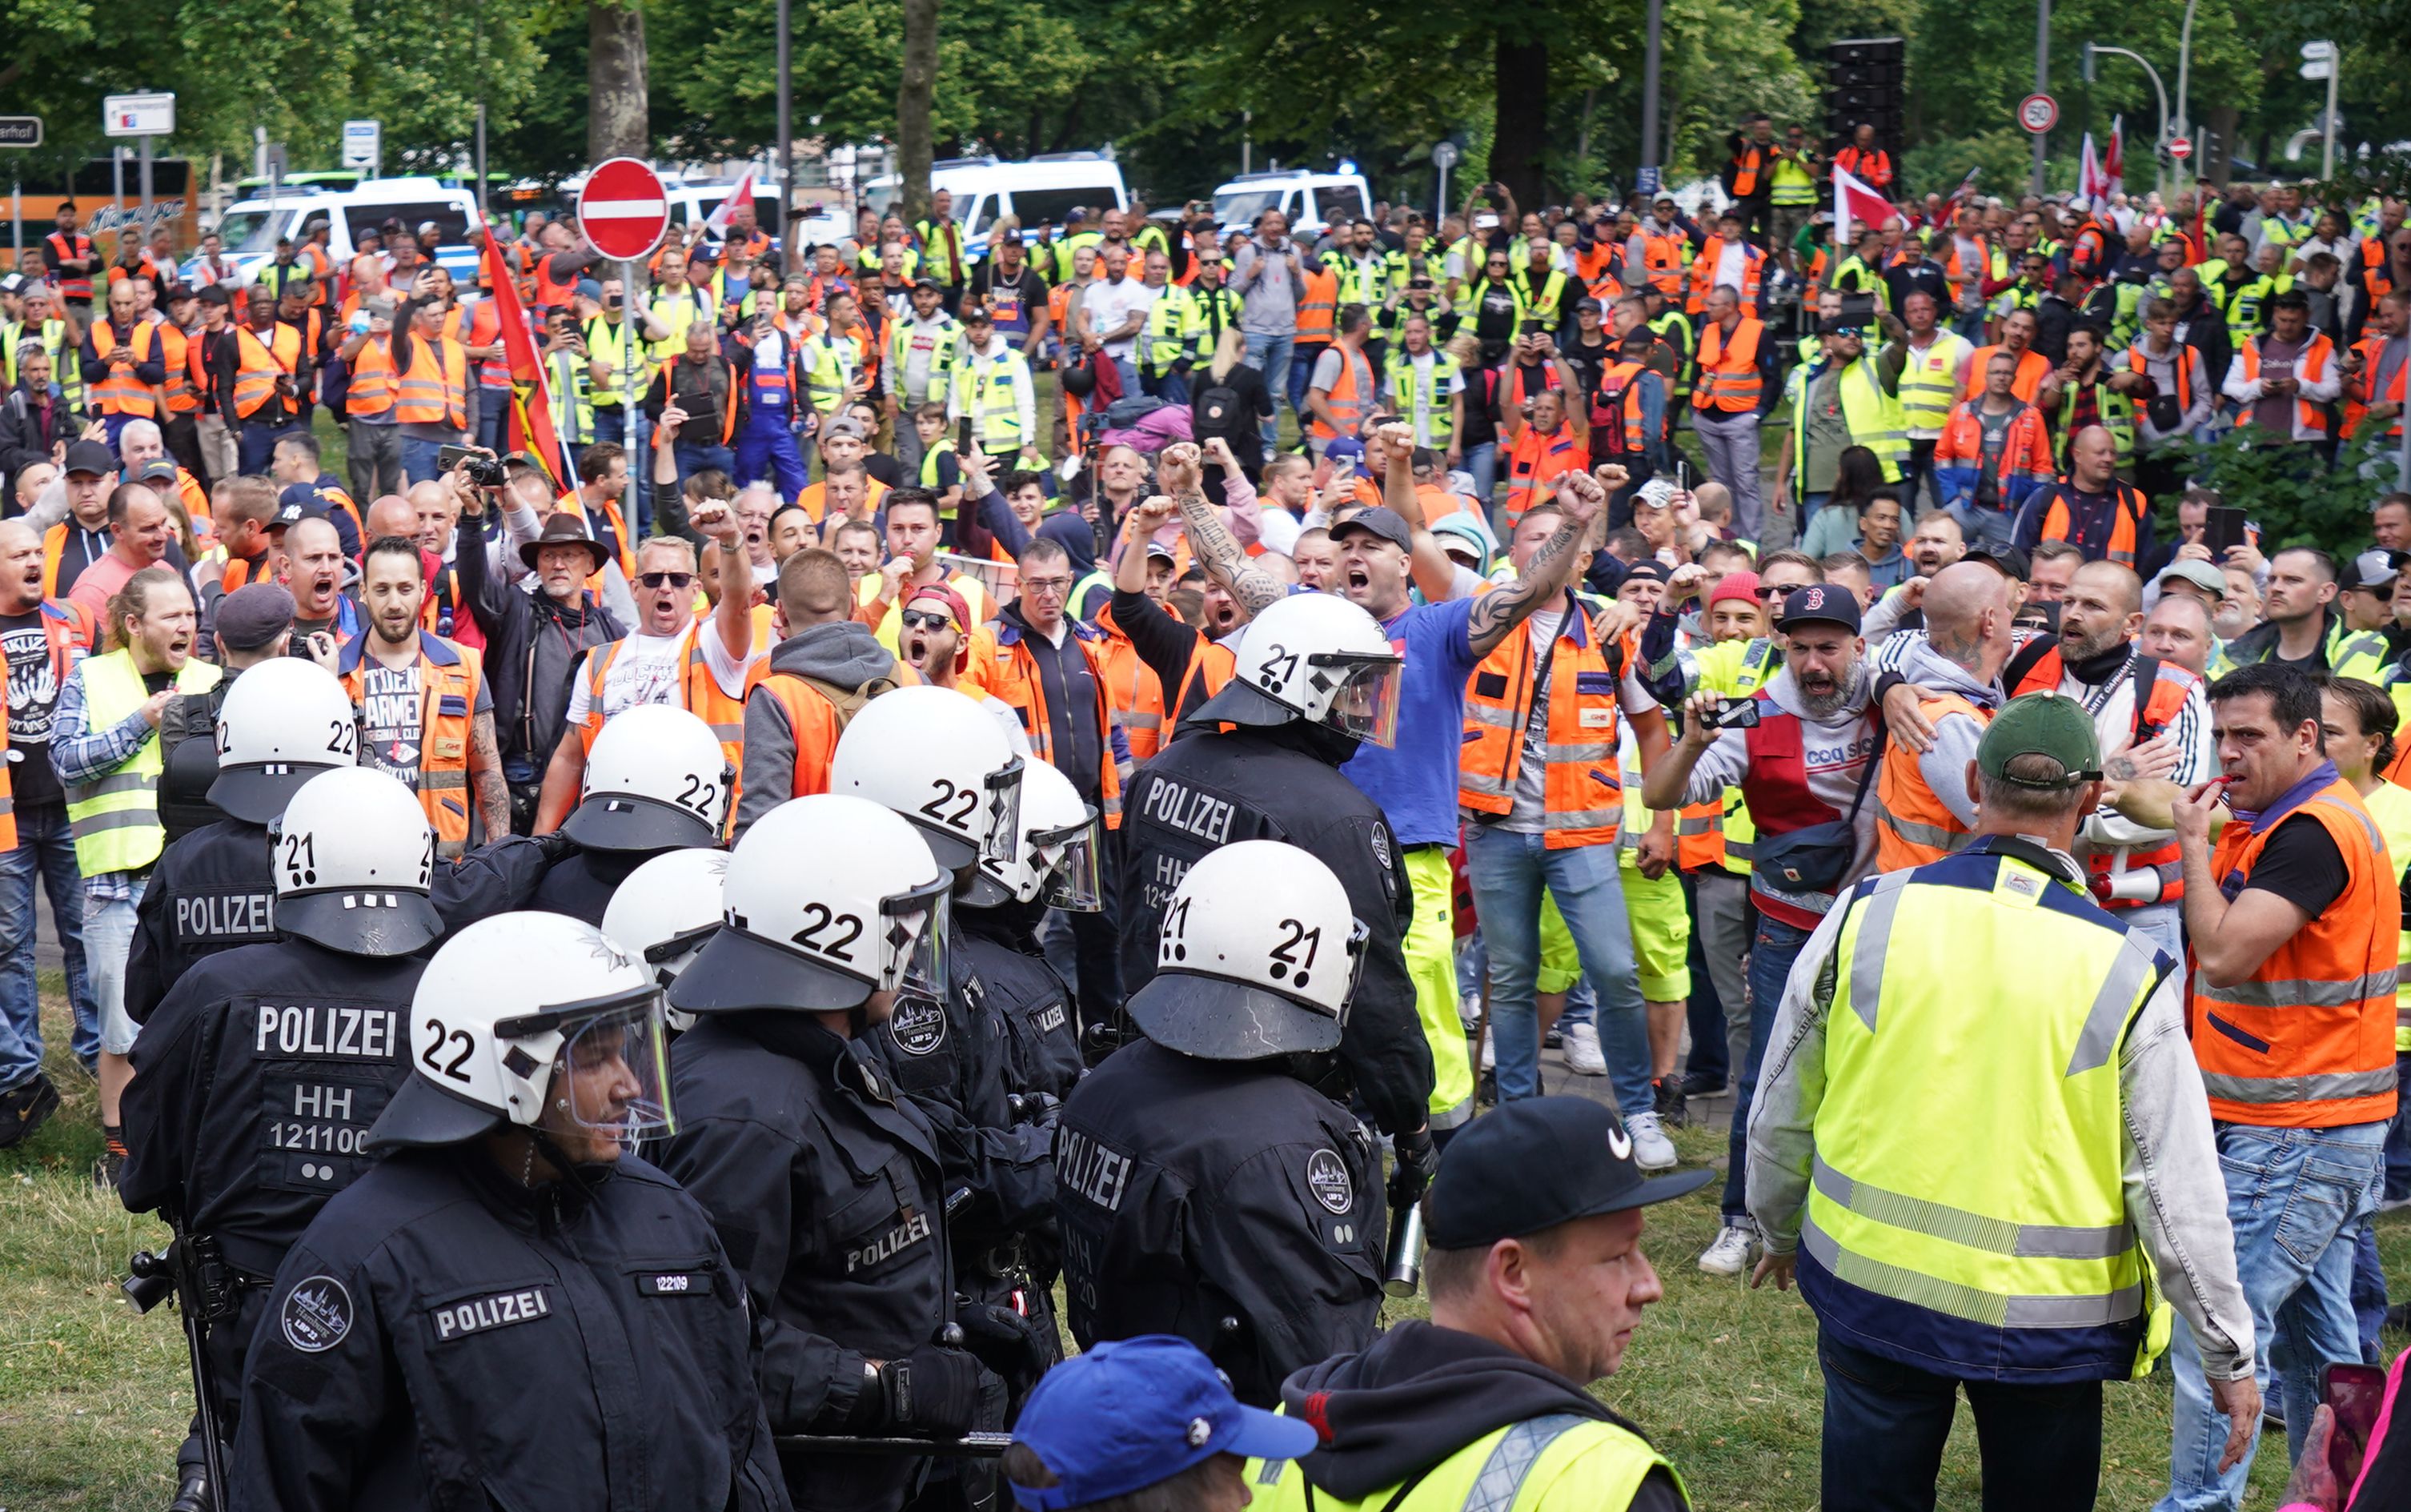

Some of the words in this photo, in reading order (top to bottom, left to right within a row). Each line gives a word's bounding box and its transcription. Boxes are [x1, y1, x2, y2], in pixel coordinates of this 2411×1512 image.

[1804, 588, 1825, 610] B
[1259, 644, 1300, 684] 21
[327, 720, 354, 755] 22
[1807, 747, 1845, 764] coq
[676, 774, 715, 816] 22
[920, 779, 978, 830] 22
[1144, 776, 1235, 845] POLIZEI
[286, 832, 315, 870] 21
[177, 893, 275, 936] POLIZEI
[791, 903, 863, 963] 22
[1163, 896, 1192, 939] 21
[1270, 919, 1321, 969] 21
[256, 1006, 397, 1057] POLIZEI
[422, 1018, 475, 1084] 22
[294, 1084, 352, 1120] HH
[1056, 1125, 1131, 1211] POLIZEI
[848, 1213, 930, 1273] POLIZEI
[295, 1305, 330, 1338] Hamburg
[437, 1289, 548, 1338] POLIZEI
